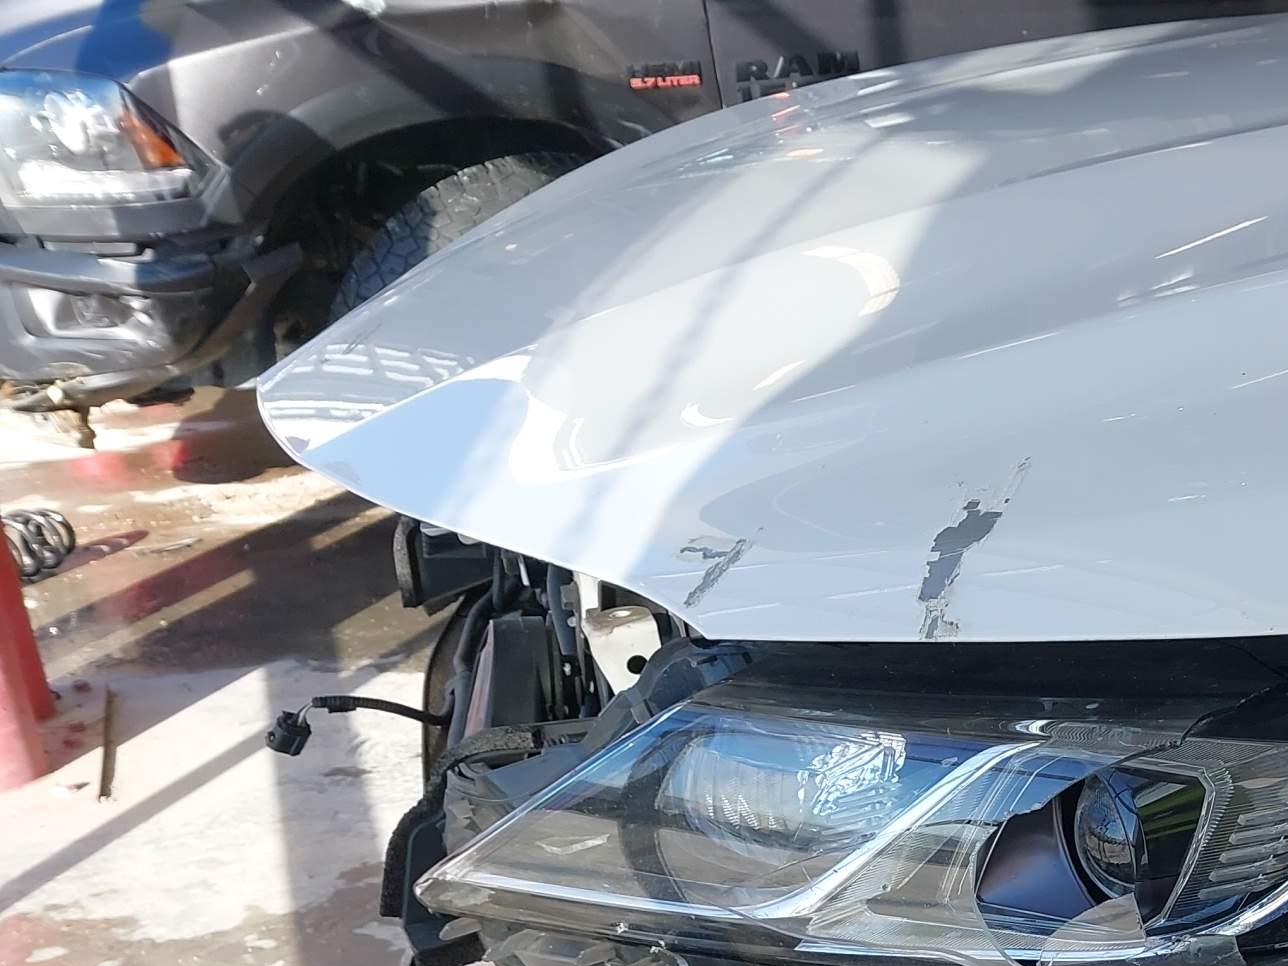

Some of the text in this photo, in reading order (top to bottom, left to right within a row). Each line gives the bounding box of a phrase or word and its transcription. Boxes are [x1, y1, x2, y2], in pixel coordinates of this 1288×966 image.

[625, 60, 702, 78] HEMI
[735, 50, 861, 83] RAM
[629, 75, 701, 89] 5.7 LITER
